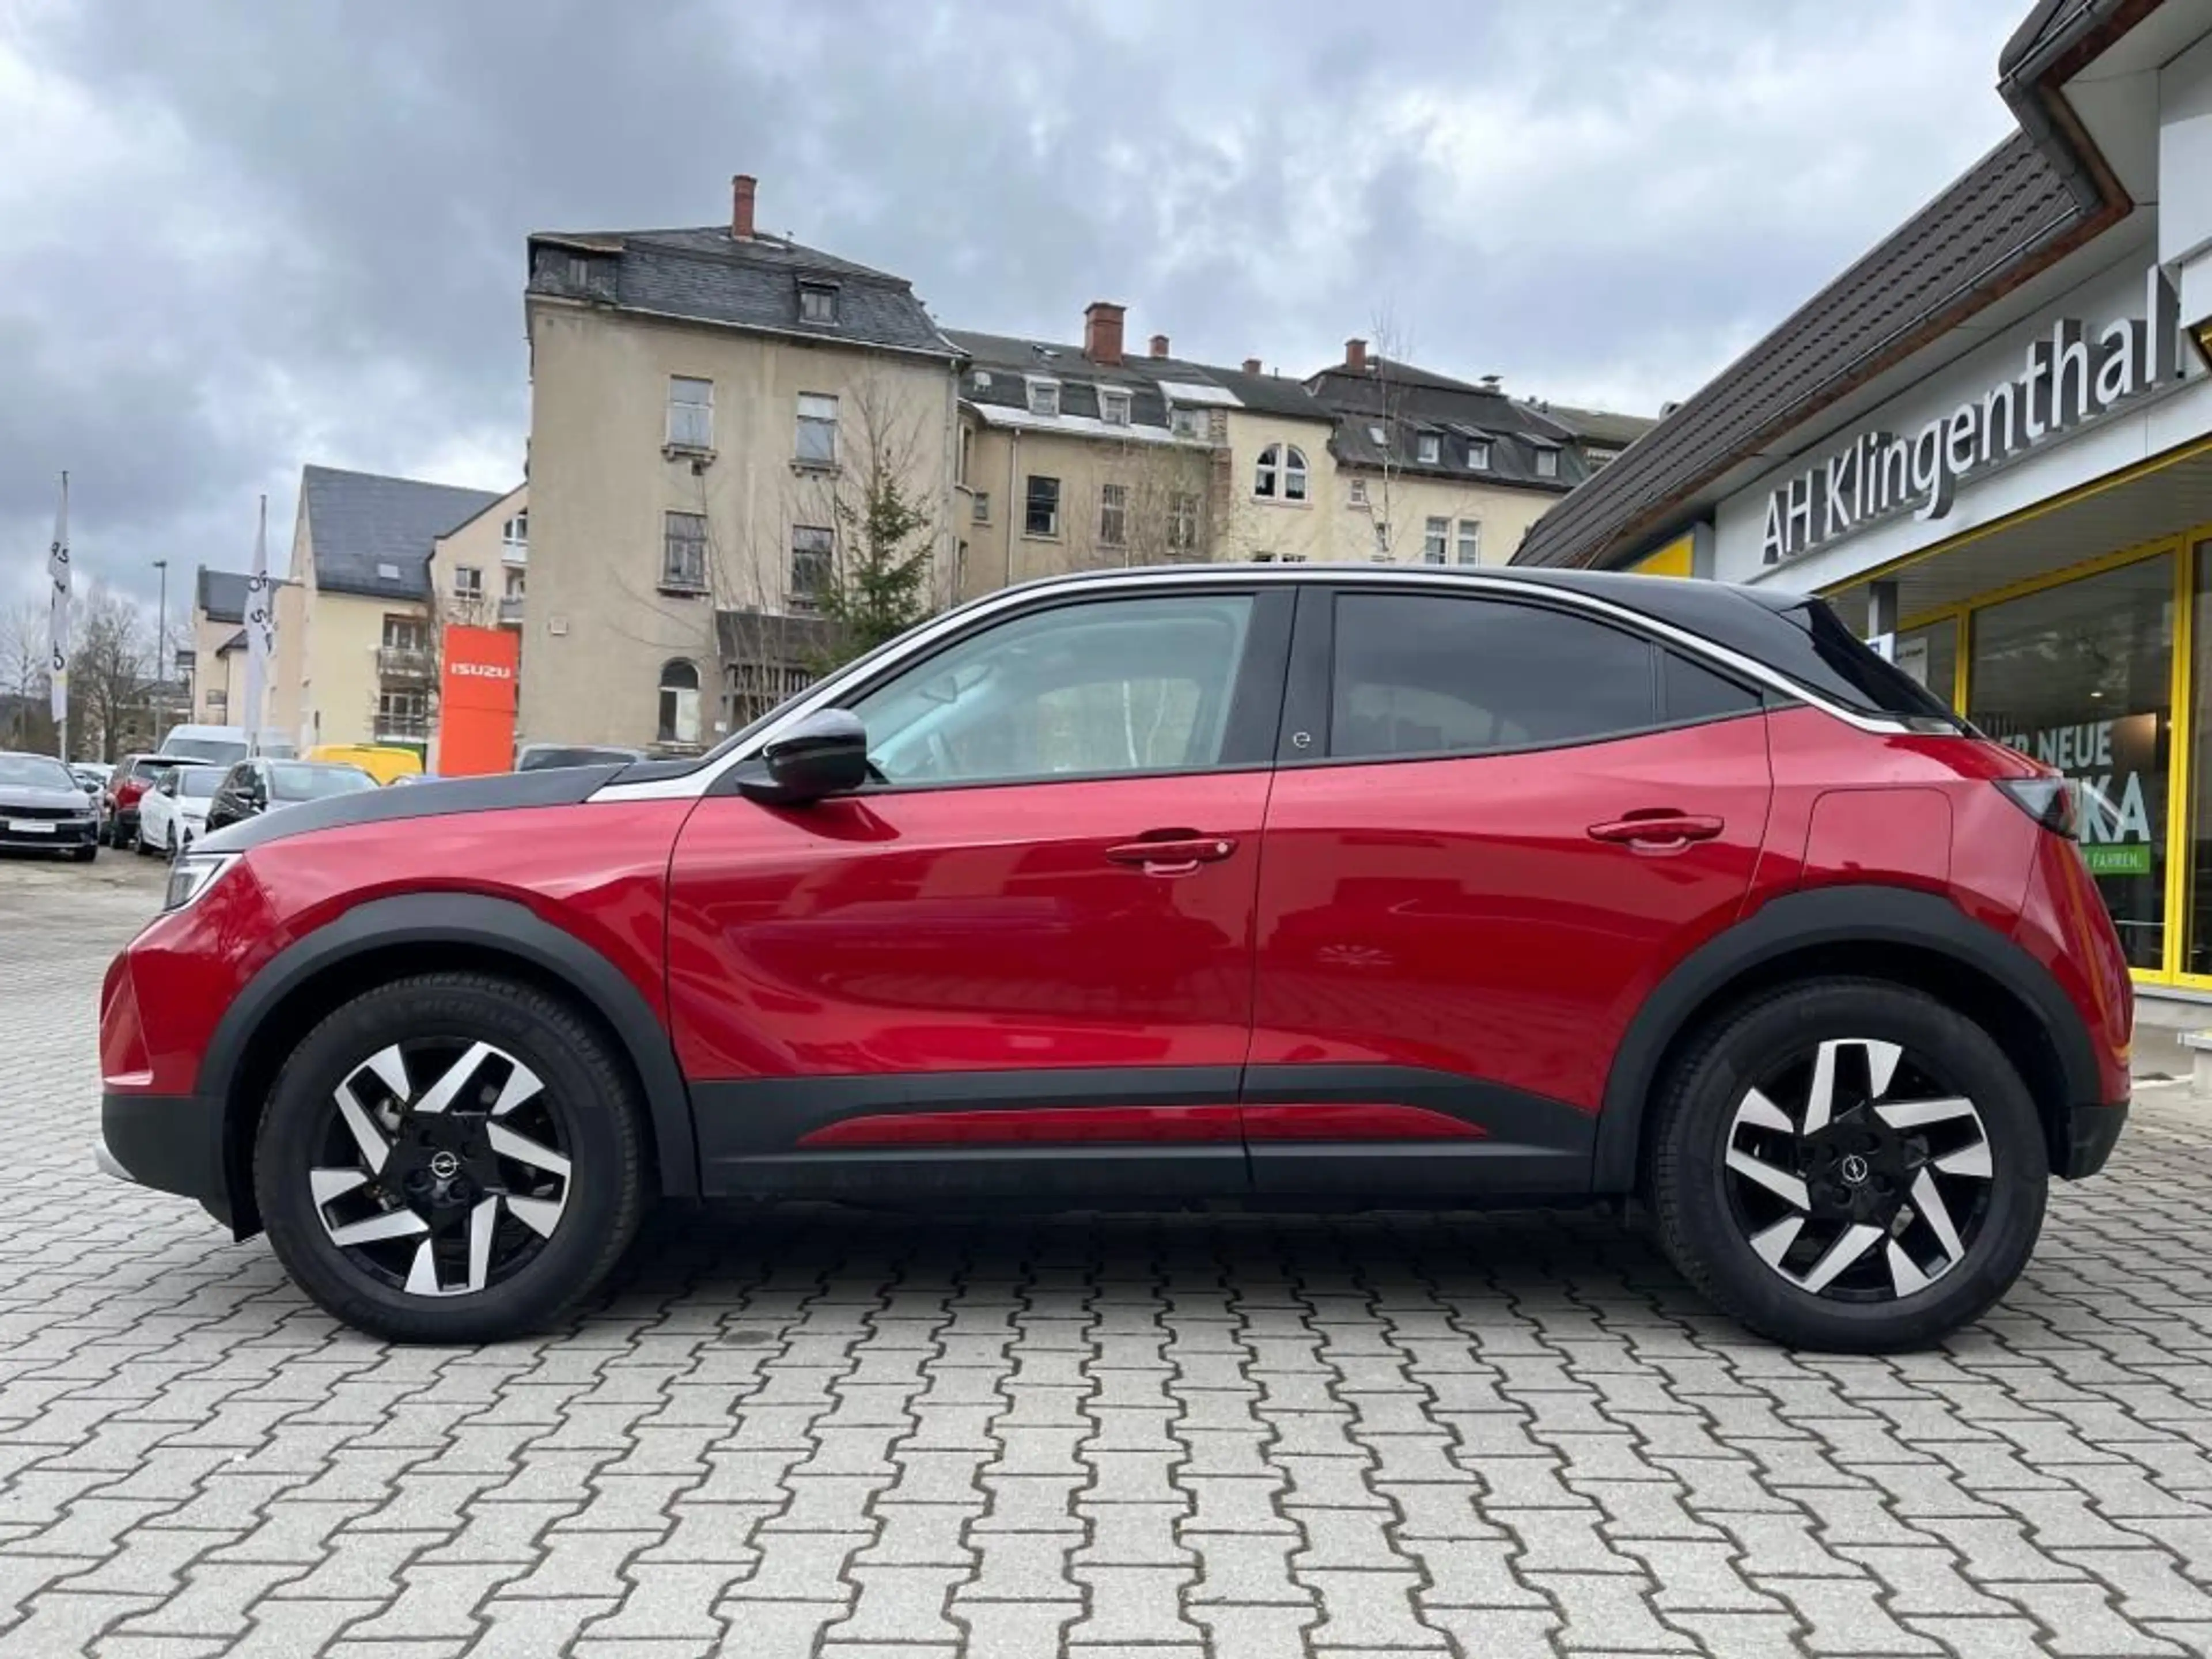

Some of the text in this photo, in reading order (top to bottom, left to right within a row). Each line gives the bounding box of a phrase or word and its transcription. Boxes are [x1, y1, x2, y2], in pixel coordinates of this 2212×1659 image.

[1763, 263, 2158, 563] AH Klingenthal
[451, 662, 510, 679] ISUZU
[2037, 721, 2113, 768] NEUE
